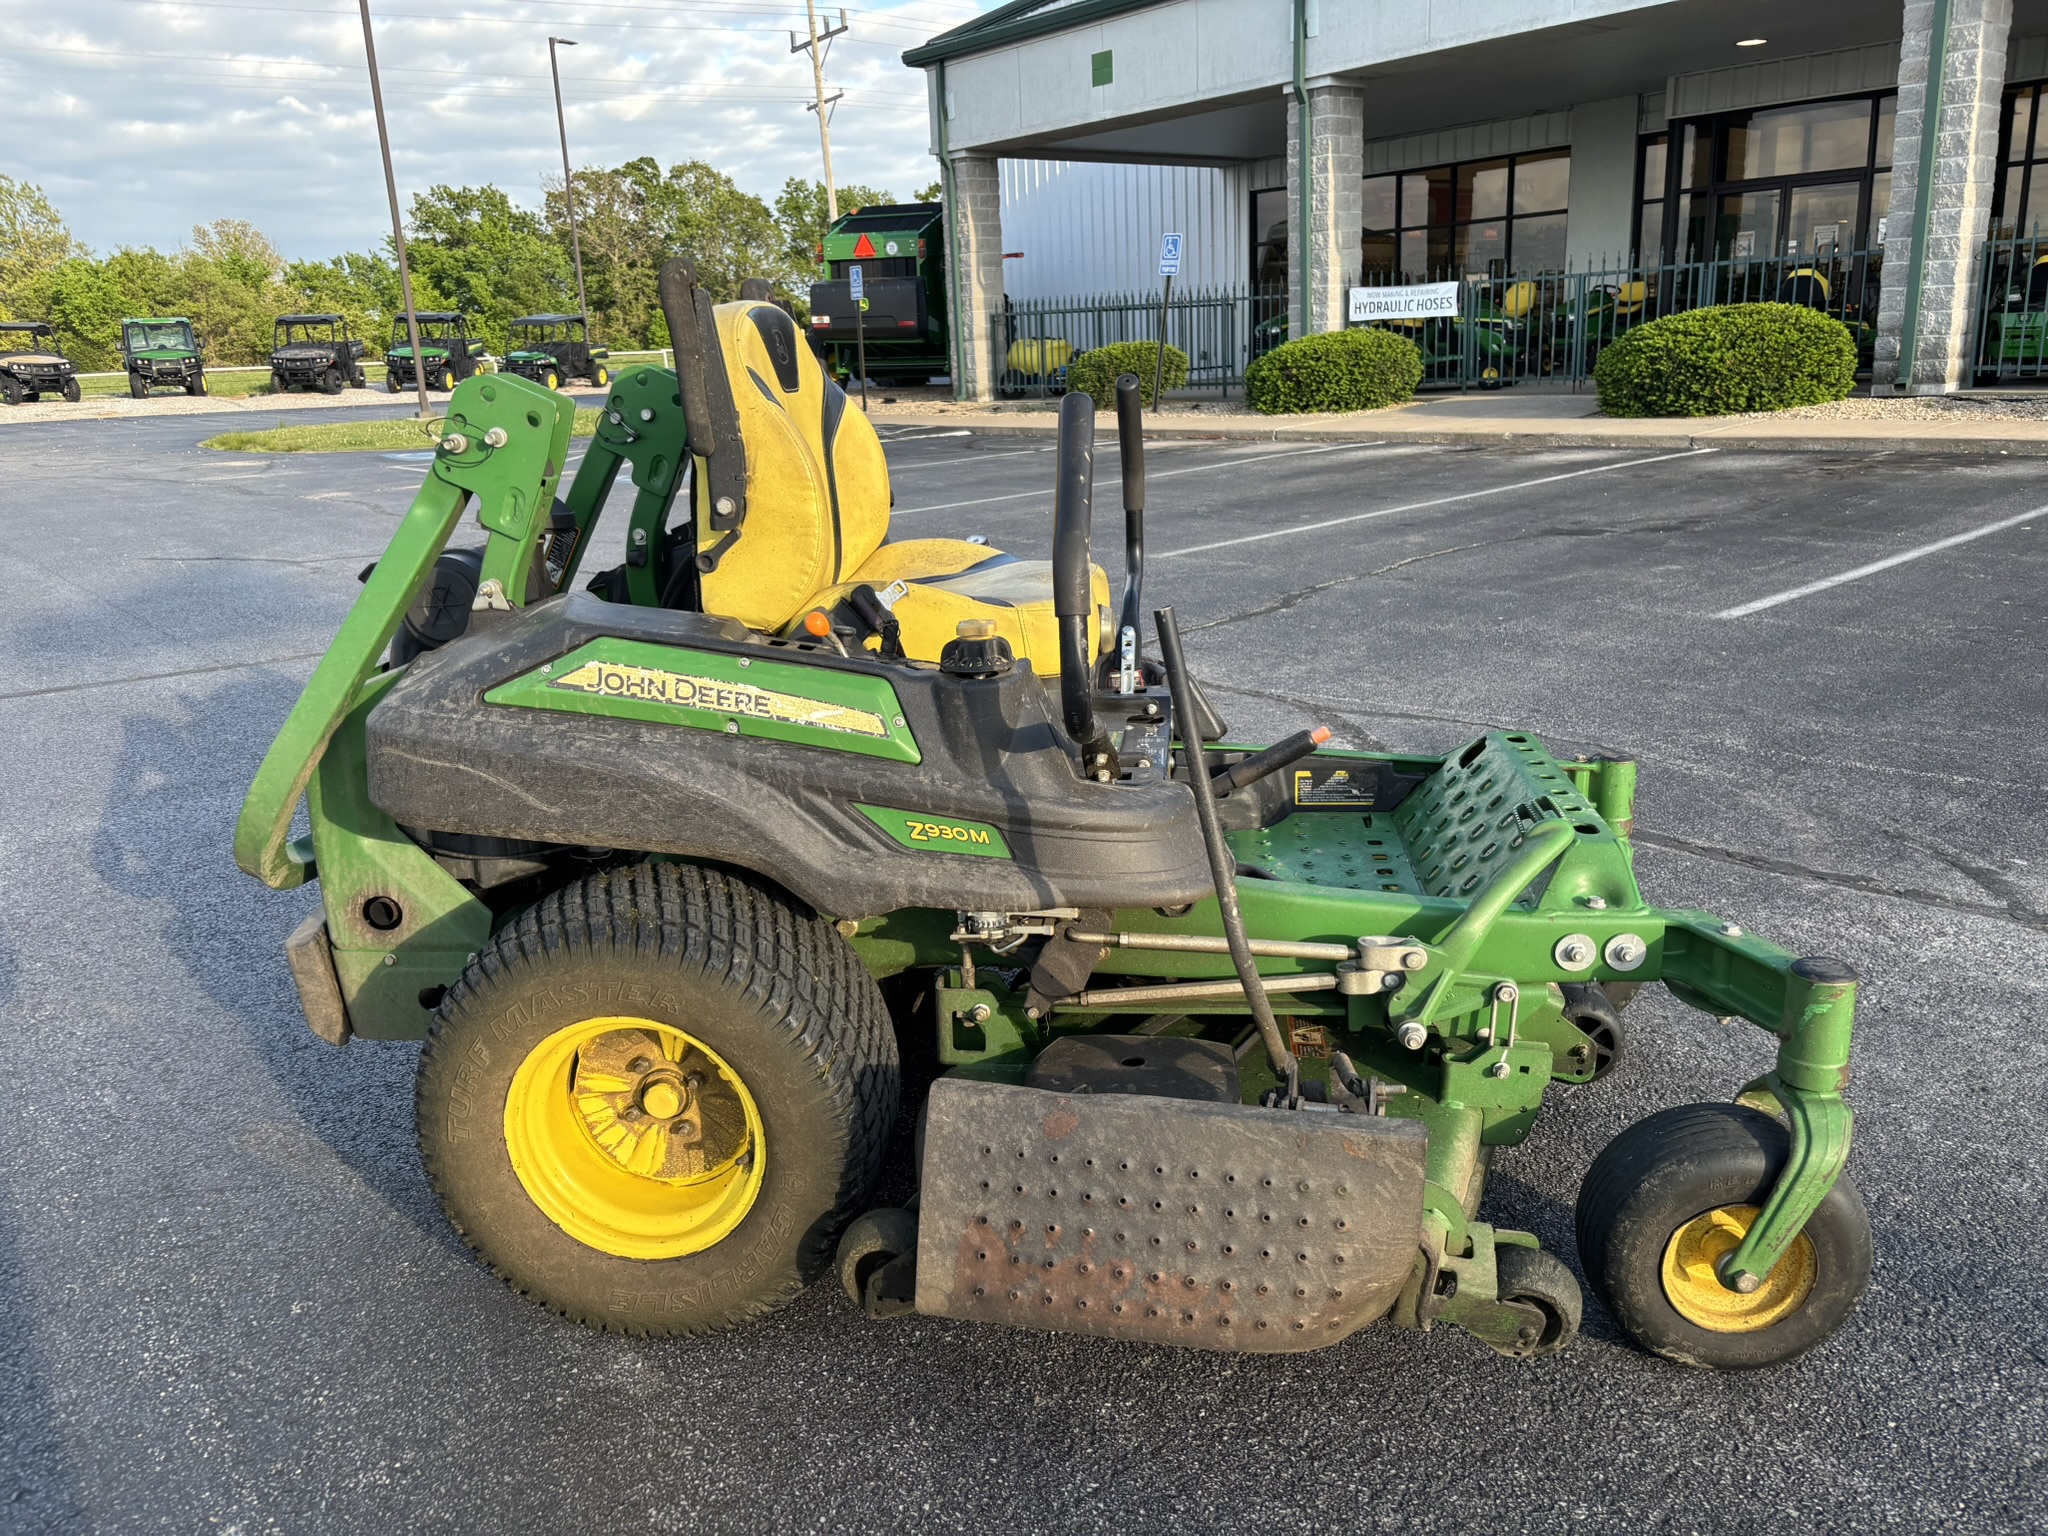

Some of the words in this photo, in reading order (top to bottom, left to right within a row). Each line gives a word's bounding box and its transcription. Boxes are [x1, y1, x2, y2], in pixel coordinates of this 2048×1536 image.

[1354, 299, 1414, 314] HYDRAULIC
[1416, 296, 1453, 311] HOSES
[586, 667, 667, 698] JOHN
[674, 677, 771, 715] DEERE
[905, 820, 991, 845] Z930M
[447, 1036, 489, 1143] TURF
[489, 981, 685, 1042] MASTER
[608, 1204, 798, 1315] CARLISLE
